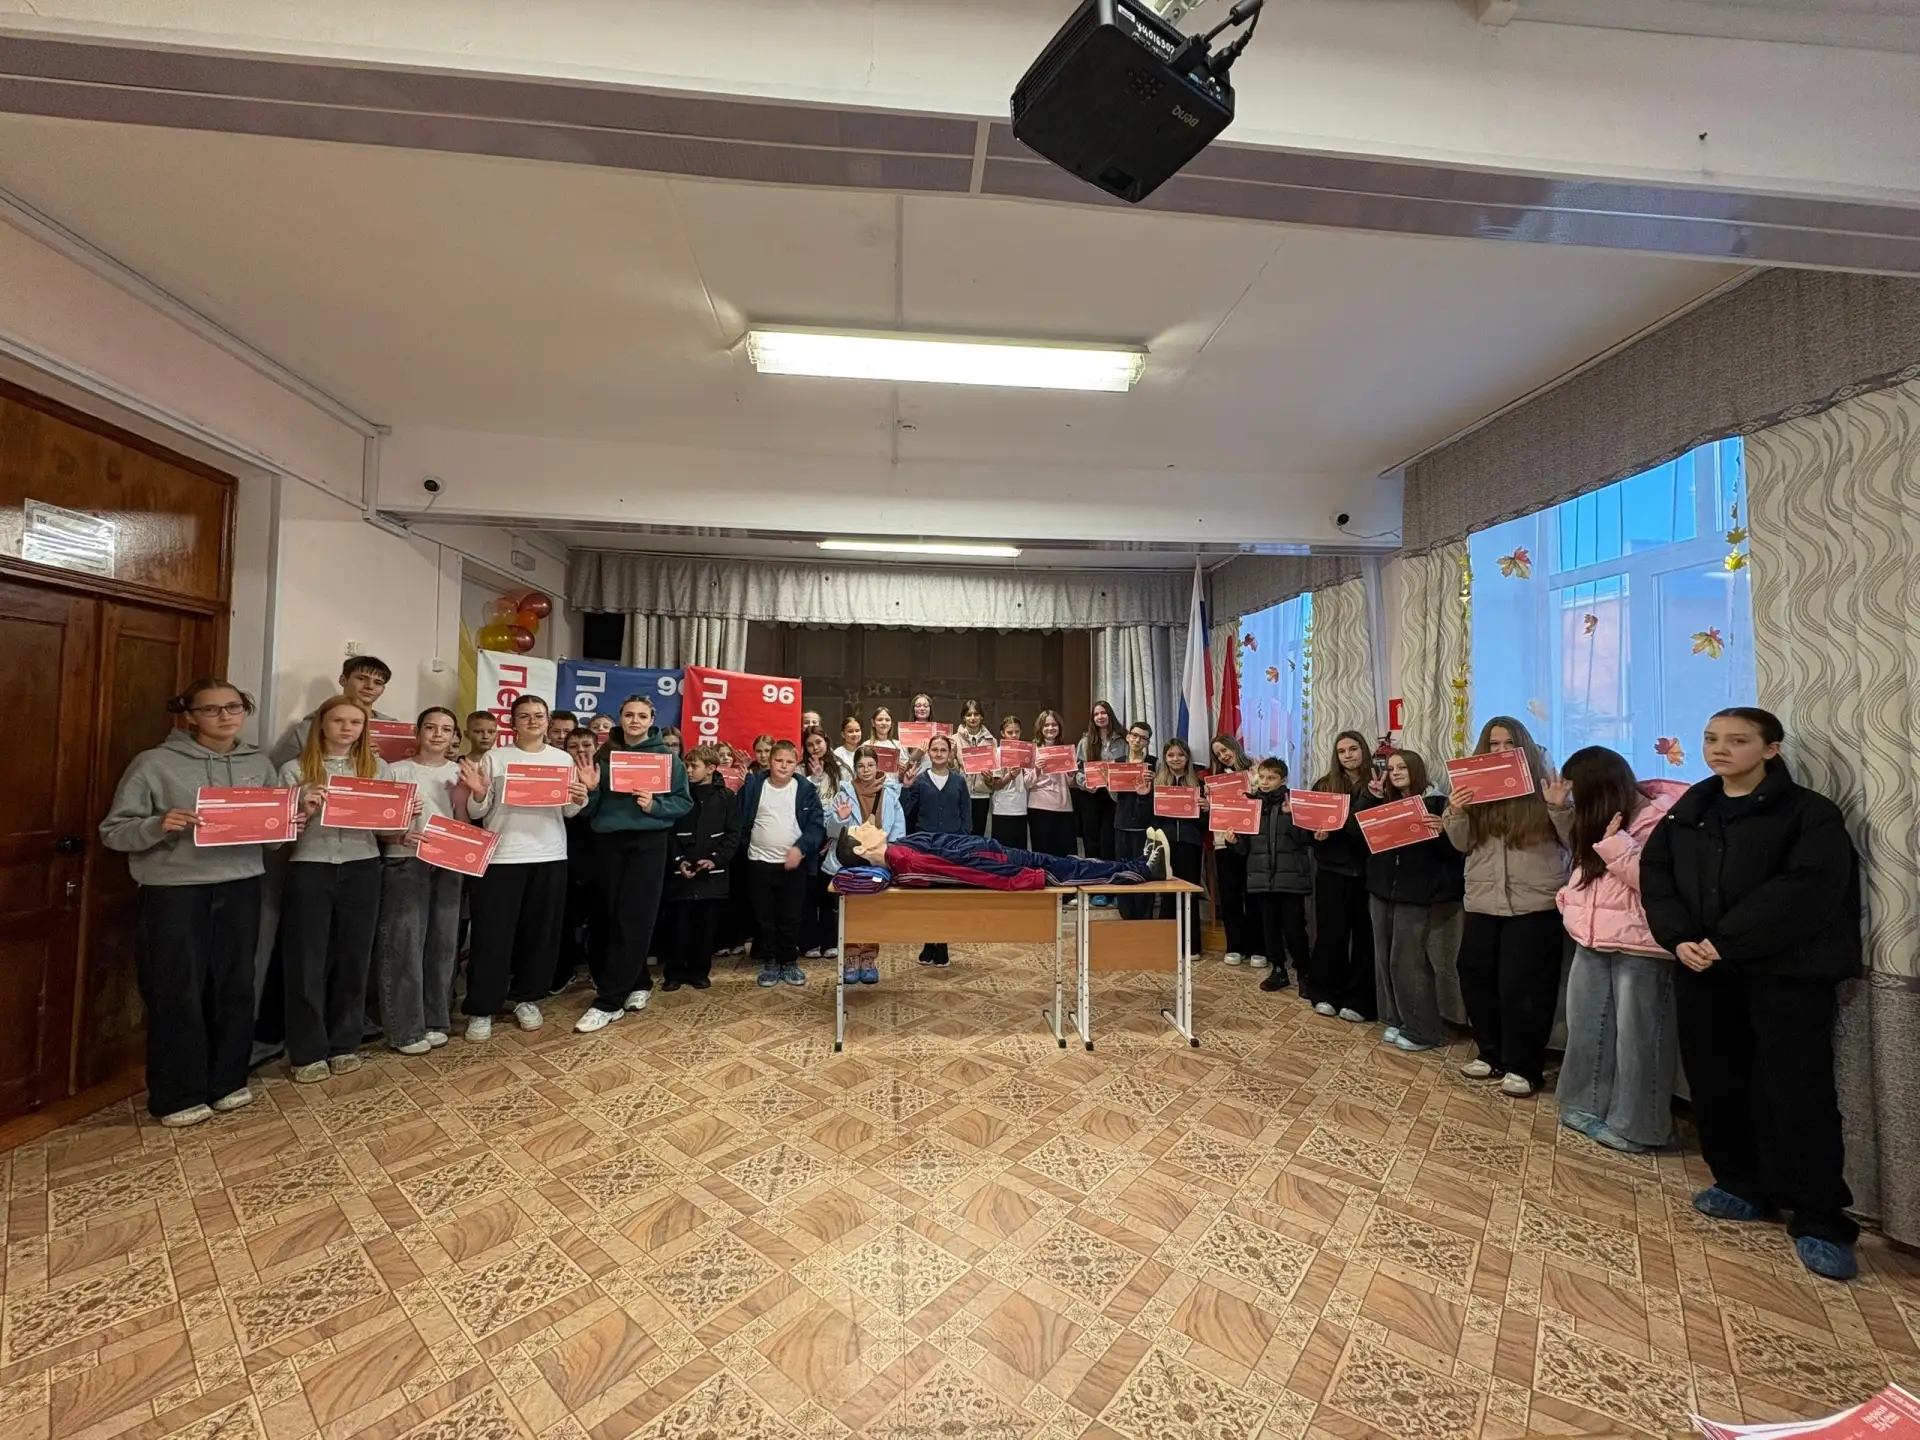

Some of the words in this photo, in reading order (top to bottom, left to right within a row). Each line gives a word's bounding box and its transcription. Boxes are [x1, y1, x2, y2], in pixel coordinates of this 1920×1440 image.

[1171, 104, 1200, 127] BenQ
[657, 676, 684, 696] 9
[762, 684, 795, 705] 96
